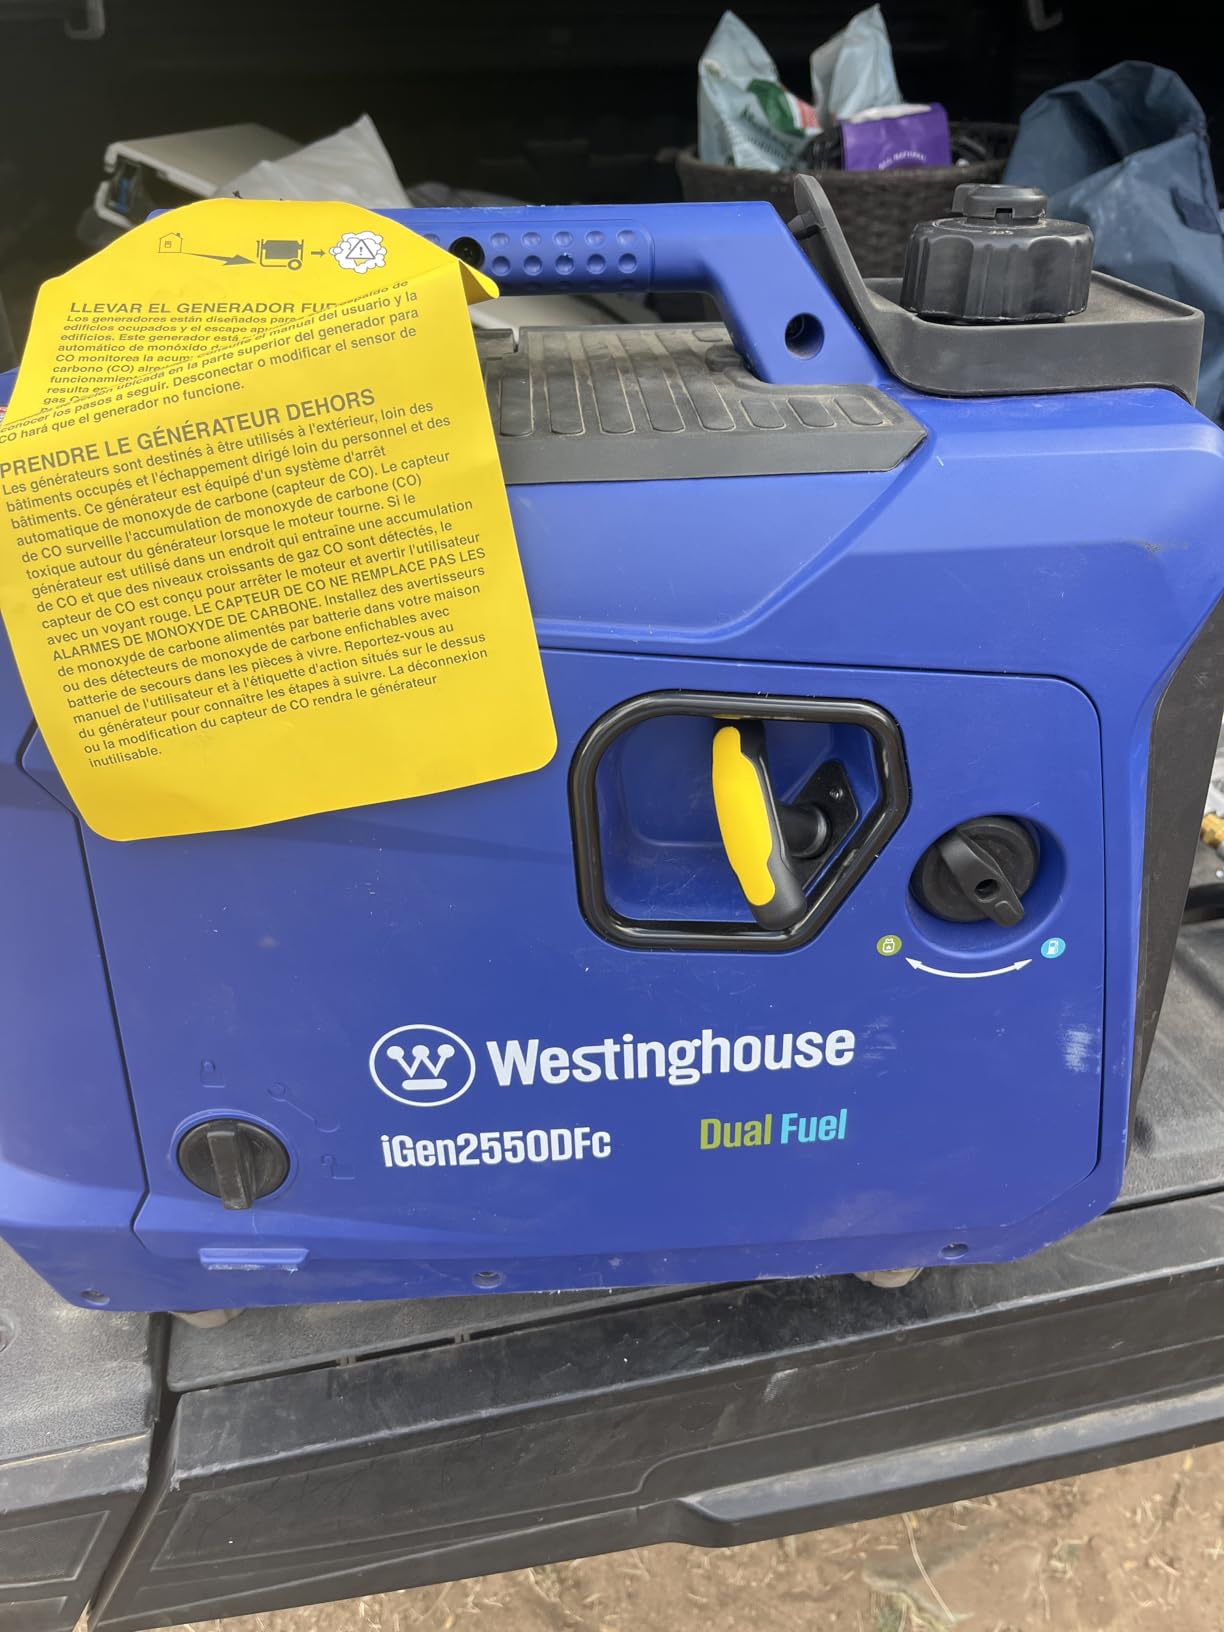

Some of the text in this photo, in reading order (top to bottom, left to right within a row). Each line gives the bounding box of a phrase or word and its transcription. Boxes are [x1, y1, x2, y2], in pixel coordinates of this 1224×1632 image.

[70, 302, 143, 313] LLEVAR
[148, 303, 171, 313] EL
[176, 302, 295, 313] GENERADOR
[117, 325, 177, 333] ocupados
[204, 326, 248, 334] escape
[170, 315, 203, 323] están
[269, 318, 314, 336] manual
[318, 309, 338, 322] del
[341, 297, 391, 316] usuario
[394, 295, 402, 308] y
[405, 291, 417, 302] la
[56, 354, 75, 362] CO
[78, 354, 140, 362] monitorea
[143, 354, 154, 362] la
[57, 343, 208, 352] automático de monóxido
[60, 333, 115, 341] edificios.
[148, 334, 211, 342] generador
[213, 334, 237, 342] está
[168, 366, 183, 375] en
[187, 362, 198, 370] la
[202, 352, 234, 368] parte
[237, 336, 291, 356] superior
[294, 329, 315, 343] del
[318, 316, 385, 341] generador
[389, 309, 419, 326] para
[52, 365, 103, 373] carbono
[107, 364, 135, 374] (CO)
[53, 408, 71, 418] los
[74, 396, 112, 414] pasos
[126, 381, 169, 398] seguir.
[173, 361, 254, 387] Desconectar
[257, 358, 266, 368] o
[269, 344, 331, 365] modificar
[335, 339, 347, 352] el
[351, 331, 396, 349] sensor
[400, 326, 417, 339] de
[0, 388, 375, 478] PRENDRE LE GÉNÉRATEUR DEHORS
[20, 423, 48, 438] hará
[51, 418, 75, 432] que
[78, 413, 90, 424] el
[93, 398, 159, 423] generador
[162, 394, 180, 405] no
[182, 381, 244, 401] funcione.
[2, 402, 433, 495] Les générateurs sont destinés à être utilisés à l'extérieur, loin des
[10, 445, 386, 529] bâtiments. Ce générateur est équipé d'un système d'arrêt
[21, 473, 422, 563] de CO surveille l'accumulation de monoxyde de carbone (CO)
[31, 501, 473, 599] générateur est utilisé dans un endroit qui entraîne une accumulation
[41, 533, 480, 629] capteur de CO est conçu pour arrêter le moteur et avertir l'utilisateur
[53, 567, 485, 662] ALARMES DE MONOXYDE DE CARBONE. Installez des avertisseurs
[67, 623, 454, 709] batterie de secours dans les pièces à vivre. Reportez-vous au
[78, 649, 488, 739] du générateur pour connaître les étapes à suivre. La déconnexion
[88, 746, 162, 768] inutilisable.
[486, 1027, 856, 1087] Westinghouse
[381, 1126, 612, 1168] iGen2550DFc
[700, 1108, 848, 1150] Dual Fuel
